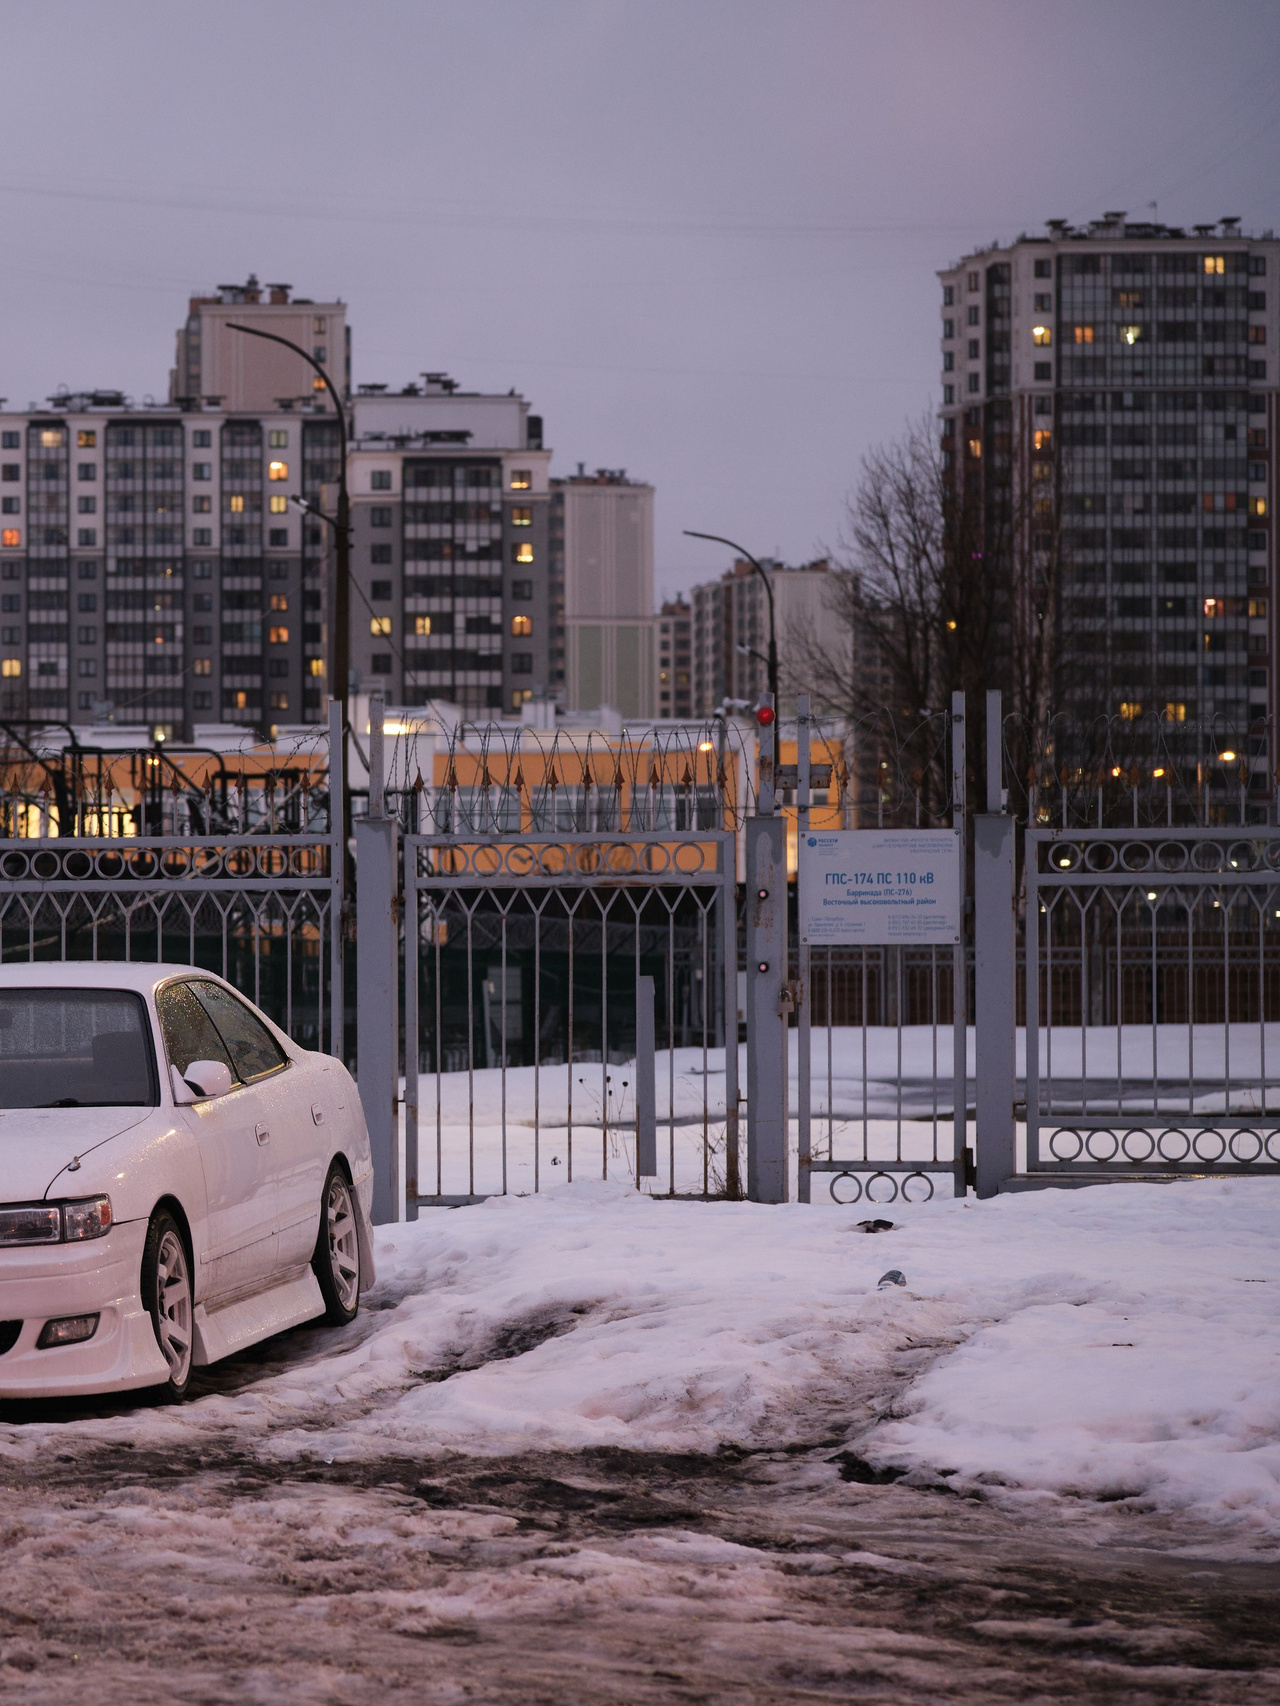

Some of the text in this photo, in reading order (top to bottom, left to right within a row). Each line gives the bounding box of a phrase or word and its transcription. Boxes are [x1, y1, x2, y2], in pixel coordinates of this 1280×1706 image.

[825, 872, 934, 885] ГПС-174 ПС 110 кВ
[846, 889, 912, 898] Баррикада (ПС-276)
[823, 898, 937, 906] Восточный высоковольтный район
